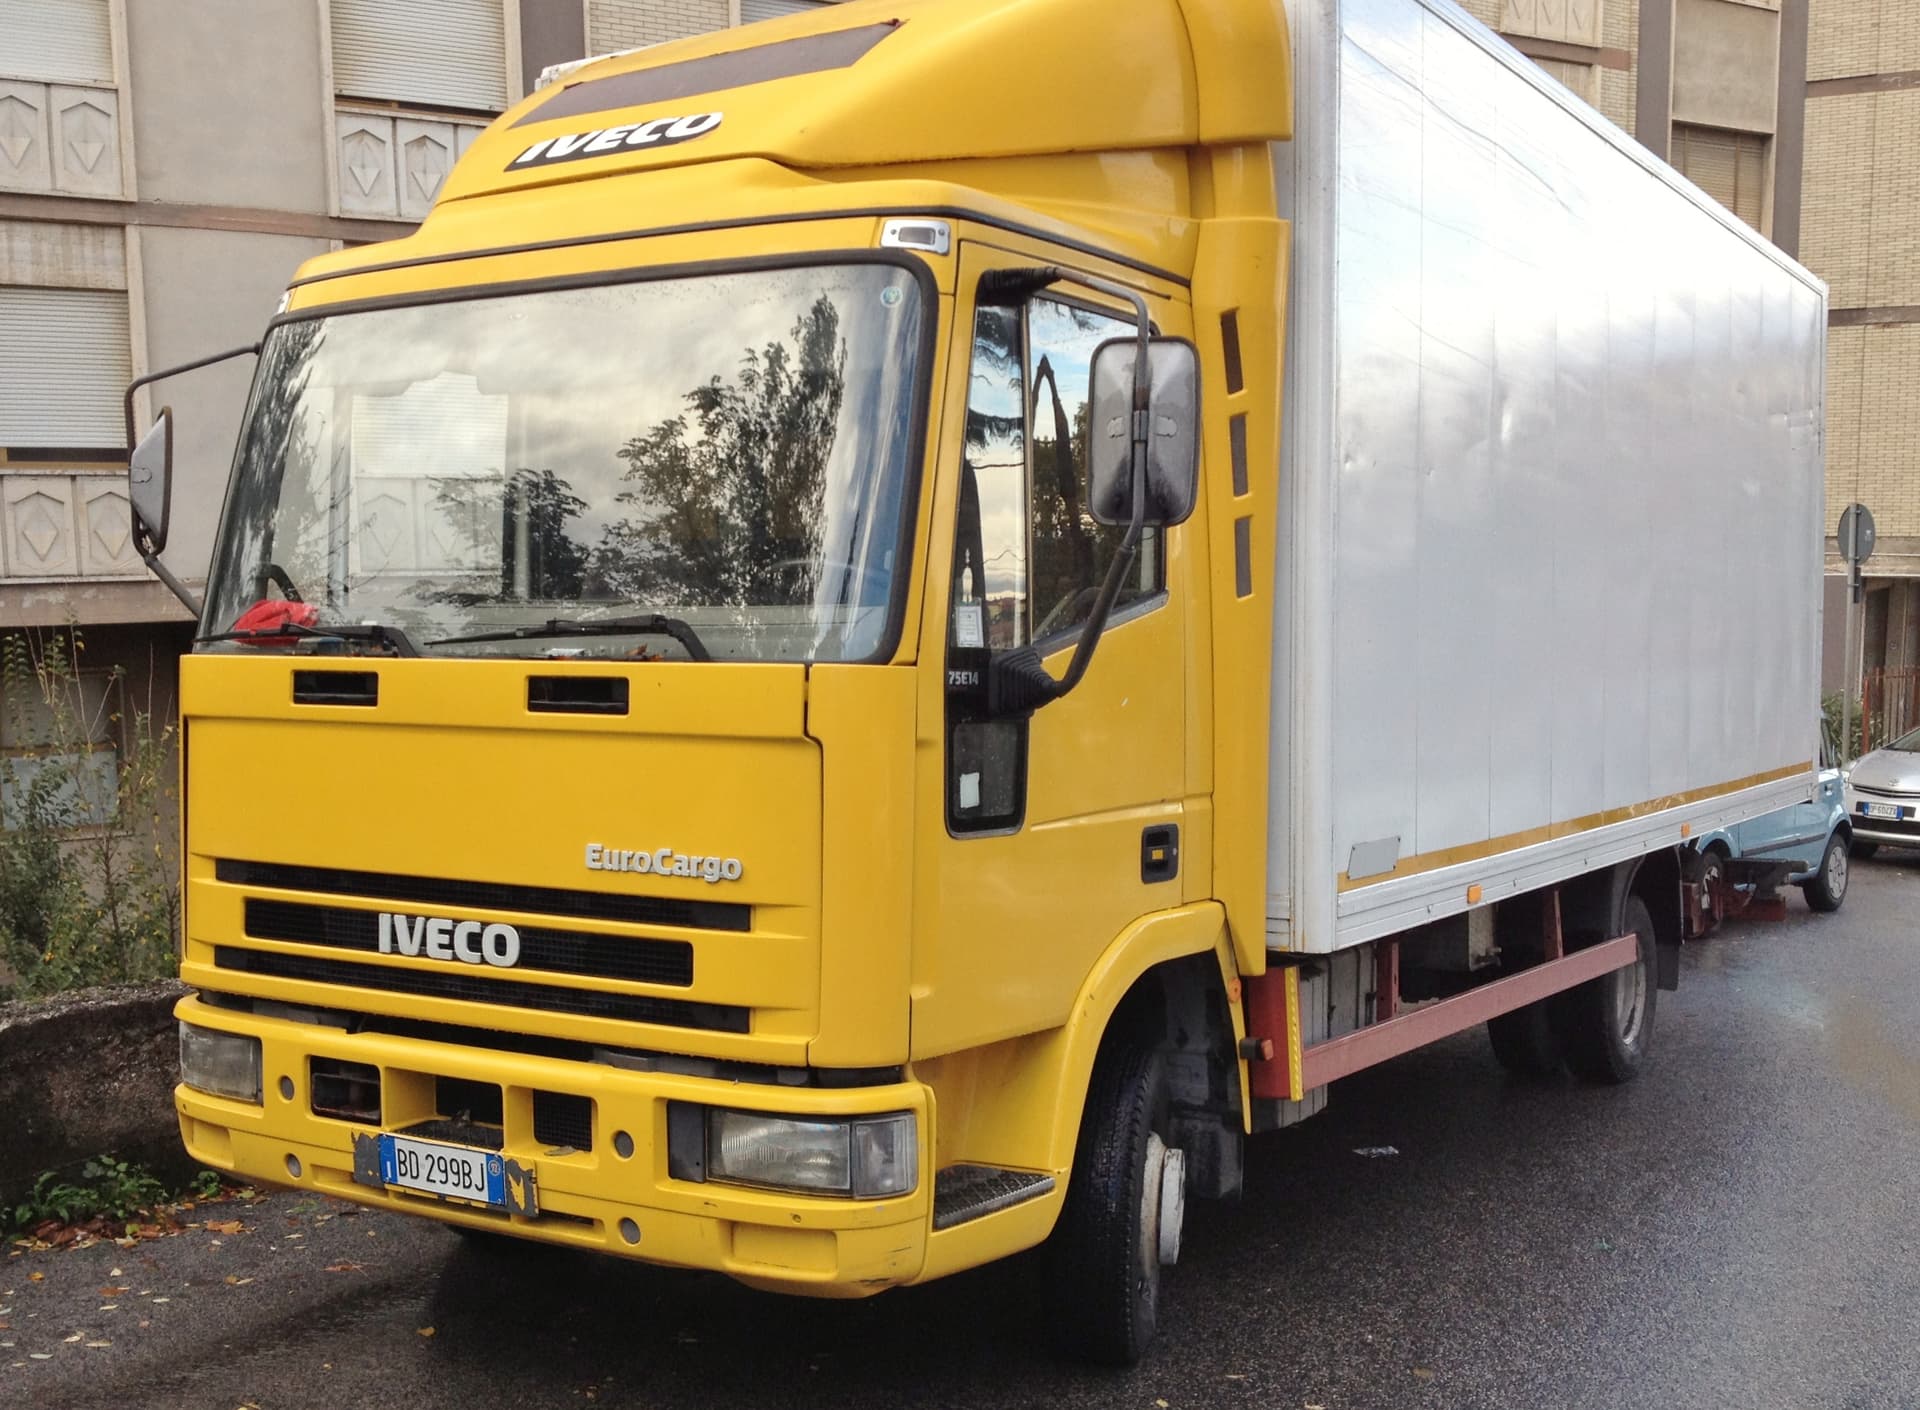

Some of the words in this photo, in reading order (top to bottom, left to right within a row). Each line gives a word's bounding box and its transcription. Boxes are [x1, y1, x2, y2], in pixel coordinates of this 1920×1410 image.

[515, 111, 723, 163] IVECO
[948, 671, 979, 685] 75E14
[585, 843, 743, 883] EuroCargo
[378, 912, 521, 968] IVECO
[397, 1148, 420, 1180] BD
[425, 1153, 485, 1192] 299BJ
